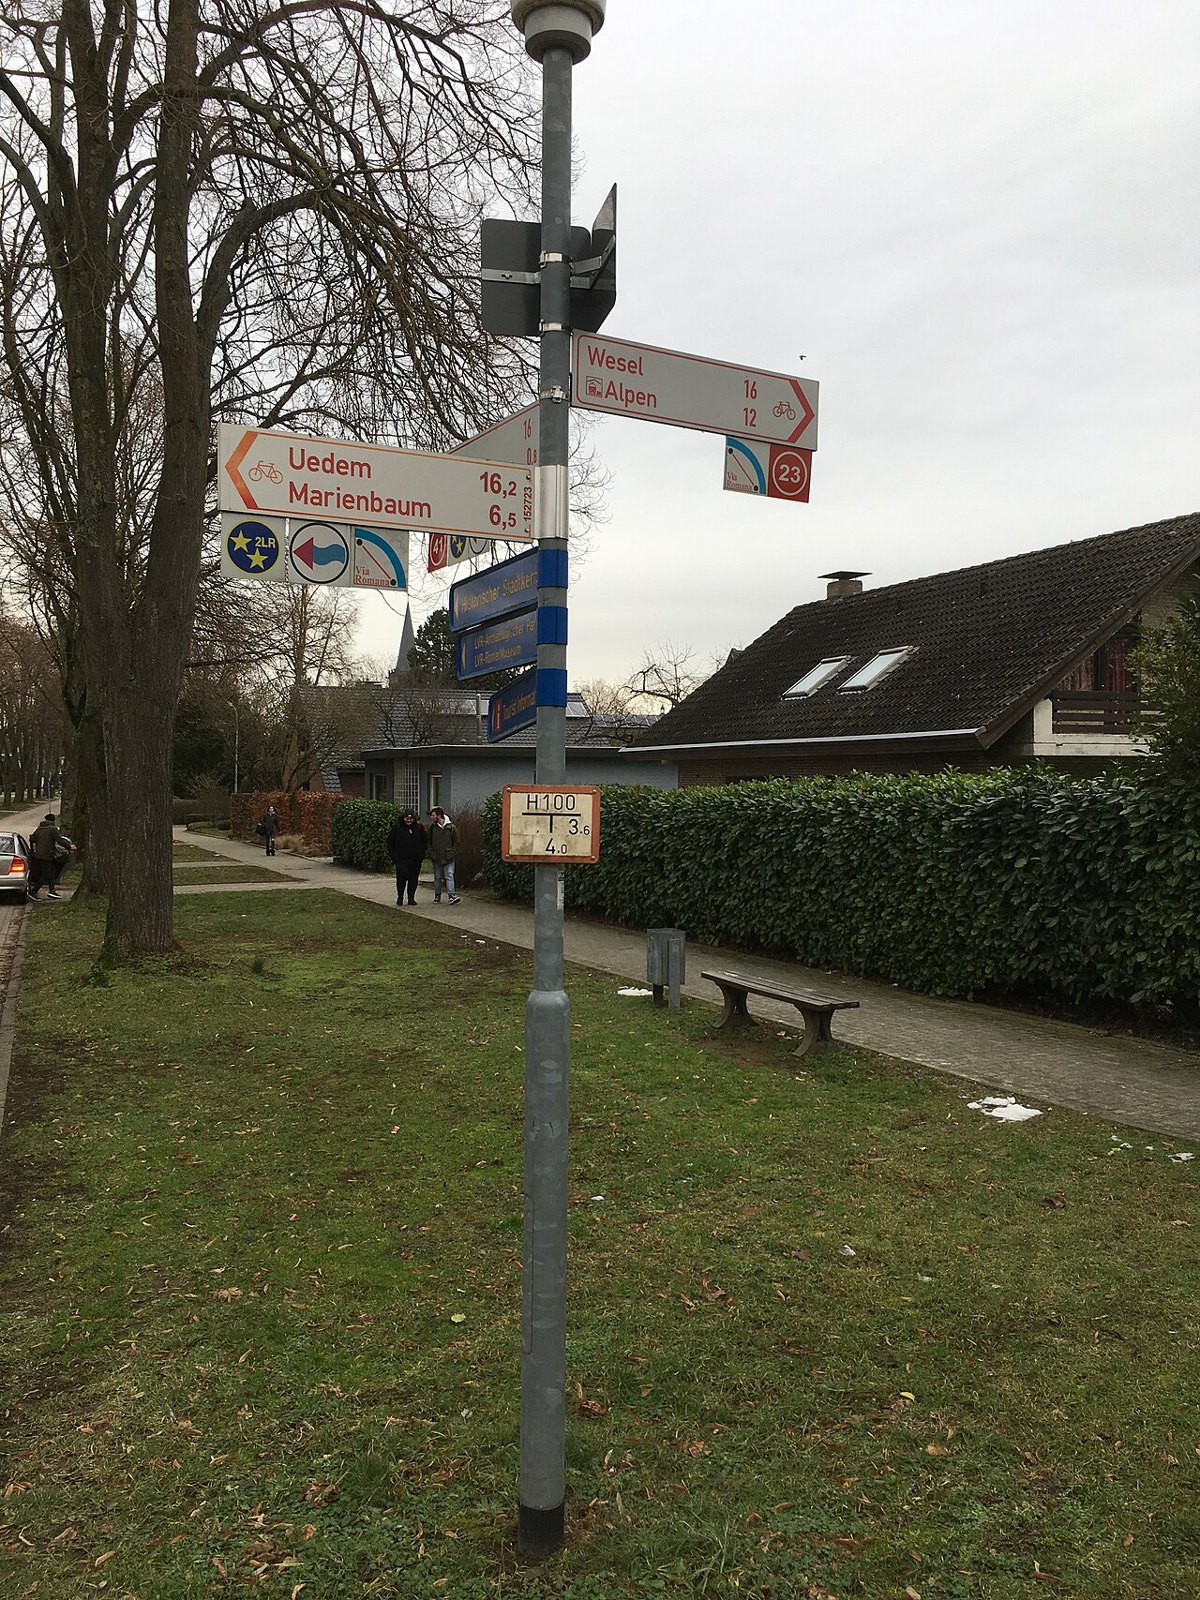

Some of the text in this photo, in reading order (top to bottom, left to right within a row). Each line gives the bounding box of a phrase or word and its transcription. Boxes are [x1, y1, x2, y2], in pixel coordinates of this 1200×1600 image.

[587, 345, 758, 400] Wesel 16
[604, 380, 757, 428] Alpen 12
[523, 418, 532, 440] 16
[288, 446, 517, 499] Uedem 16,2
[778, 464, 801, 484] 23
[288, 481, 517, 530] Marienbaum 6,5
[523, 486, 532, 521] 152723
[254, 536, 276, 549] 2LR
[354, 565, 370, 576] Via
[354, 574, 390, 586] Romana
[526, 794, 576, 811] H100
